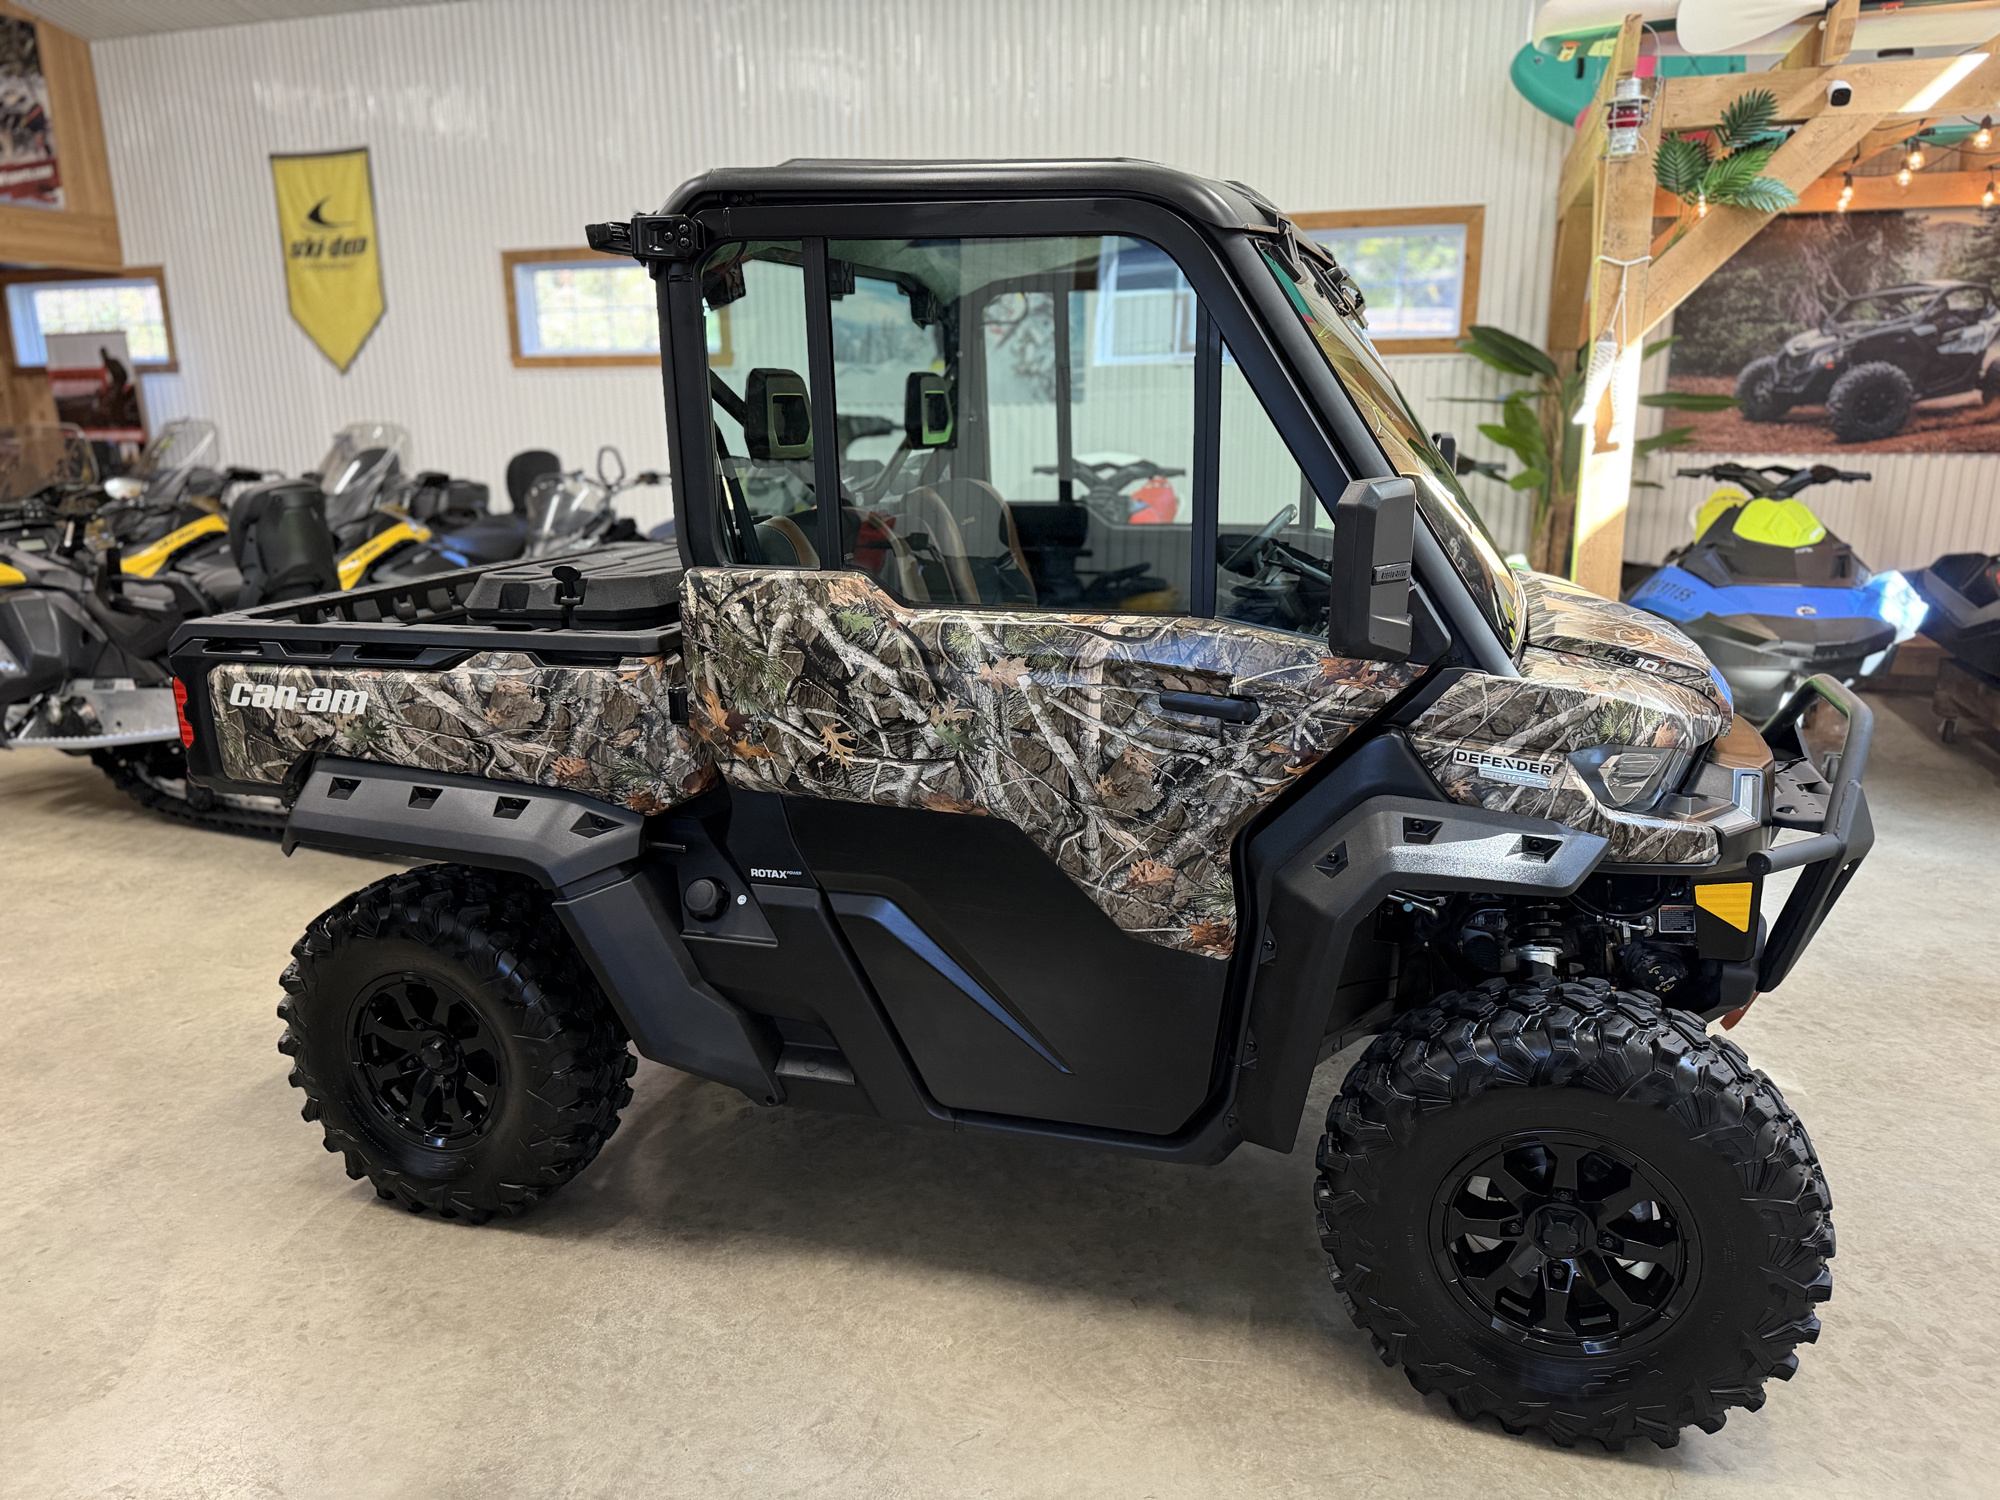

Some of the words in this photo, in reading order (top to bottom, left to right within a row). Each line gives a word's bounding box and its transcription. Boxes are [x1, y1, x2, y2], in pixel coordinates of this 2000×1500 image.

[1603, 648, 1660, 672] HD10
[229, 682, 369, 715] can-am
[1456, 751, 1552, 776] DEFENDER
[750, 868, 787, 879] ROTAX
